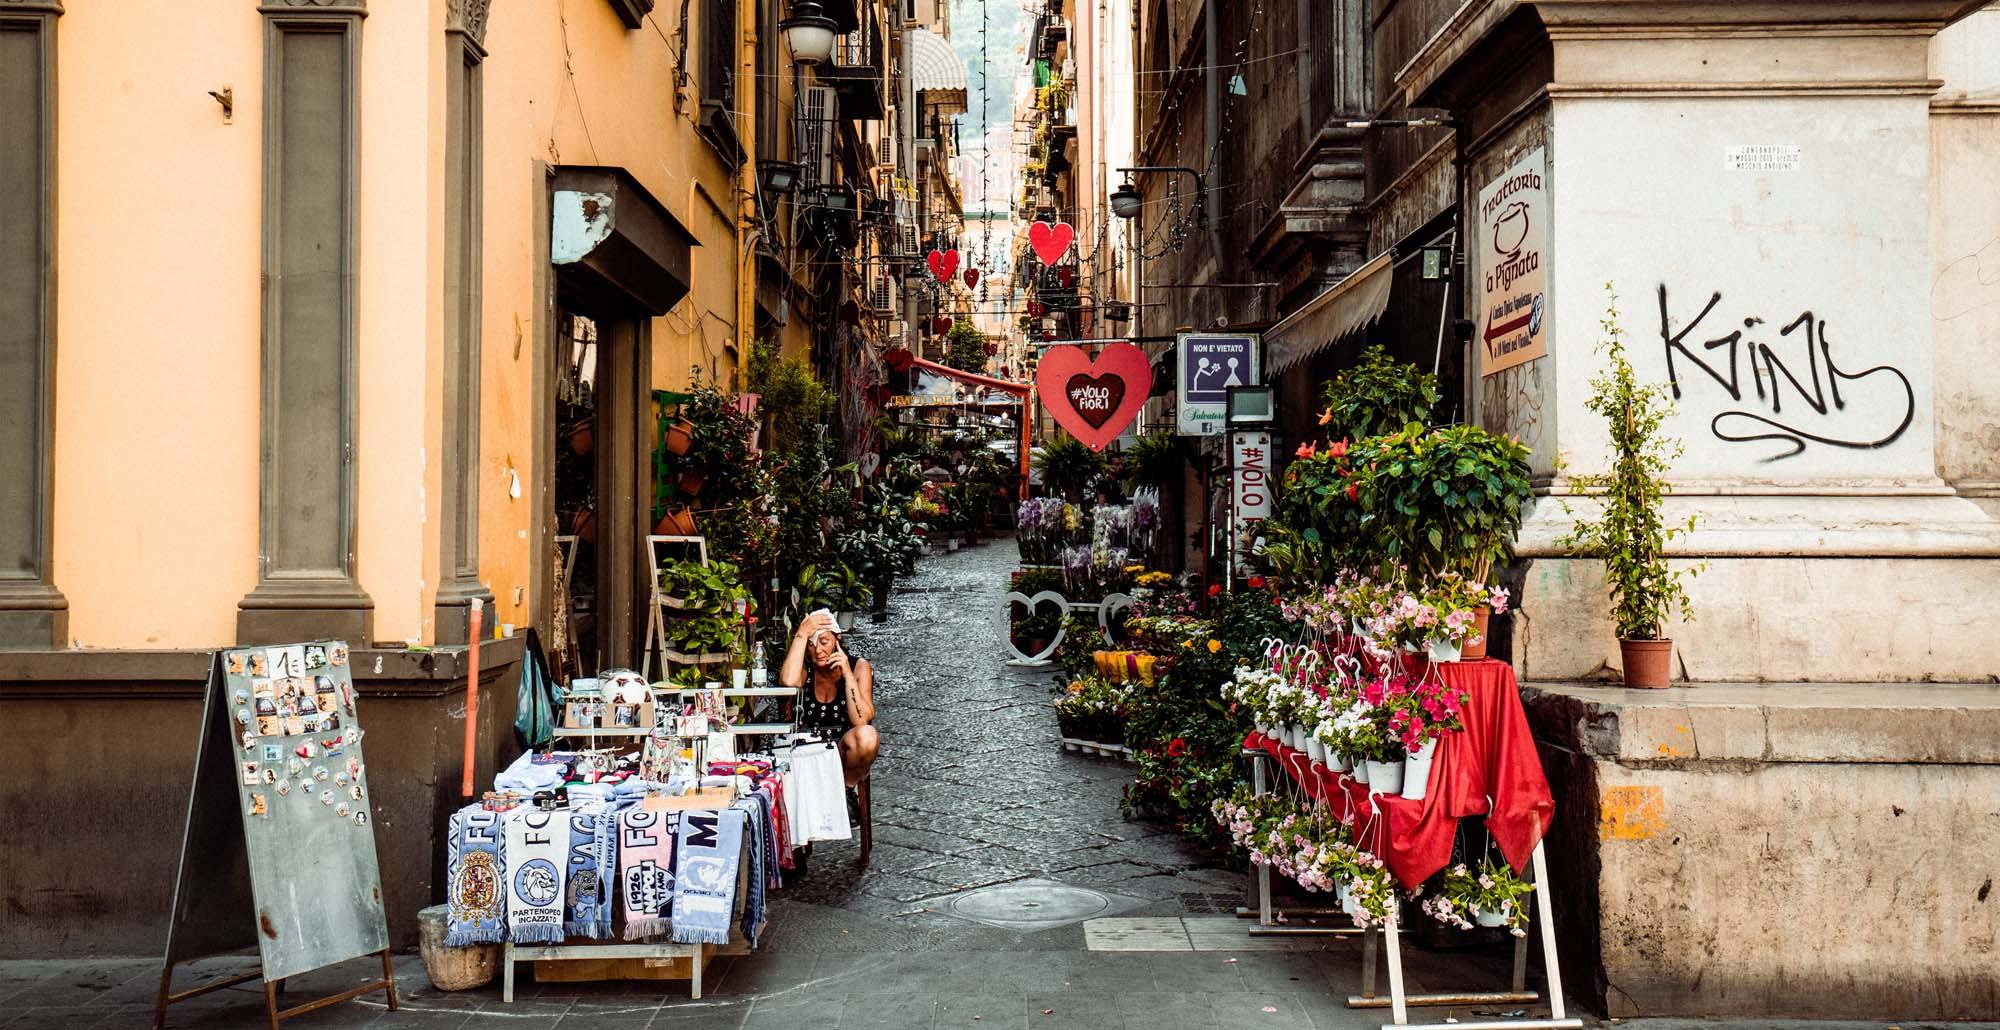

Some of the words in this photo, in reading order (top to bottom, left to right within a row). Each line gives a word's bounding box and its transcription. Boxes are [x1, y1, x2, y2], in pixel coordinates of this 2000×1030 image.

[1482, 168, 1541, 224] Trattoria
[1496, 250, 1538, 291] Pignata
[1193, 344, 1208, 353] NON
[1216, 344, 1244, 353] VIETATO
[1071, 384, 1110, 400] #VOLO
[630, 872, 642, 905] 1926
[641, 861, 657, 914] NAPOLI
[657, 871, 666, 890] AMO
[658, 891, 667, 901] TI
[512, 908, 561, 917] PARTENOPEO
[518, 916, 557, 924] INCAZZATO
